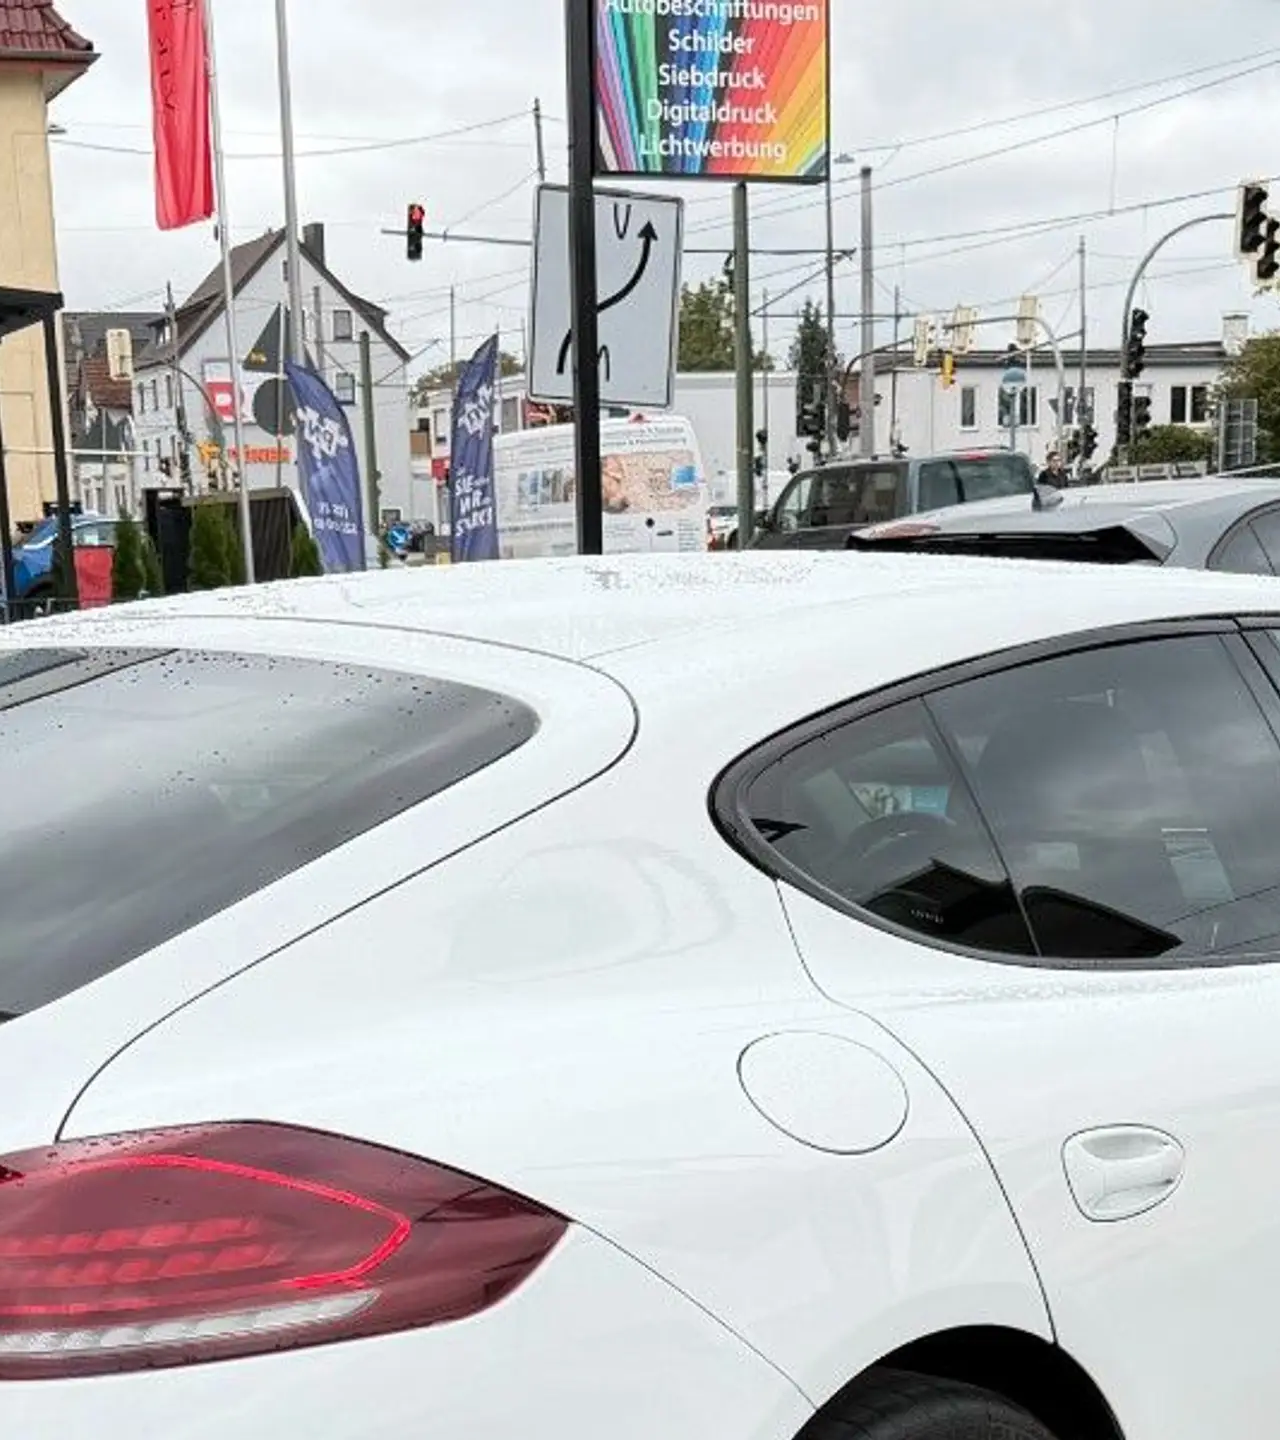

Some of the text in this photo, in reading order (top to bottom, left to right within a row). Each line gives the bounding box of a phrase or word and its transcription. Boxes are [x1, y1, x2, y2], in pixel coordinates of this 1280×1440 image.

[668, 29, 755, 53] Schilder
[658, 64, 766, 89] Siebdruck
[647, 99, 778, 126] Digitaldruck
[640, 135, 787, 161] Lichtwerbung
